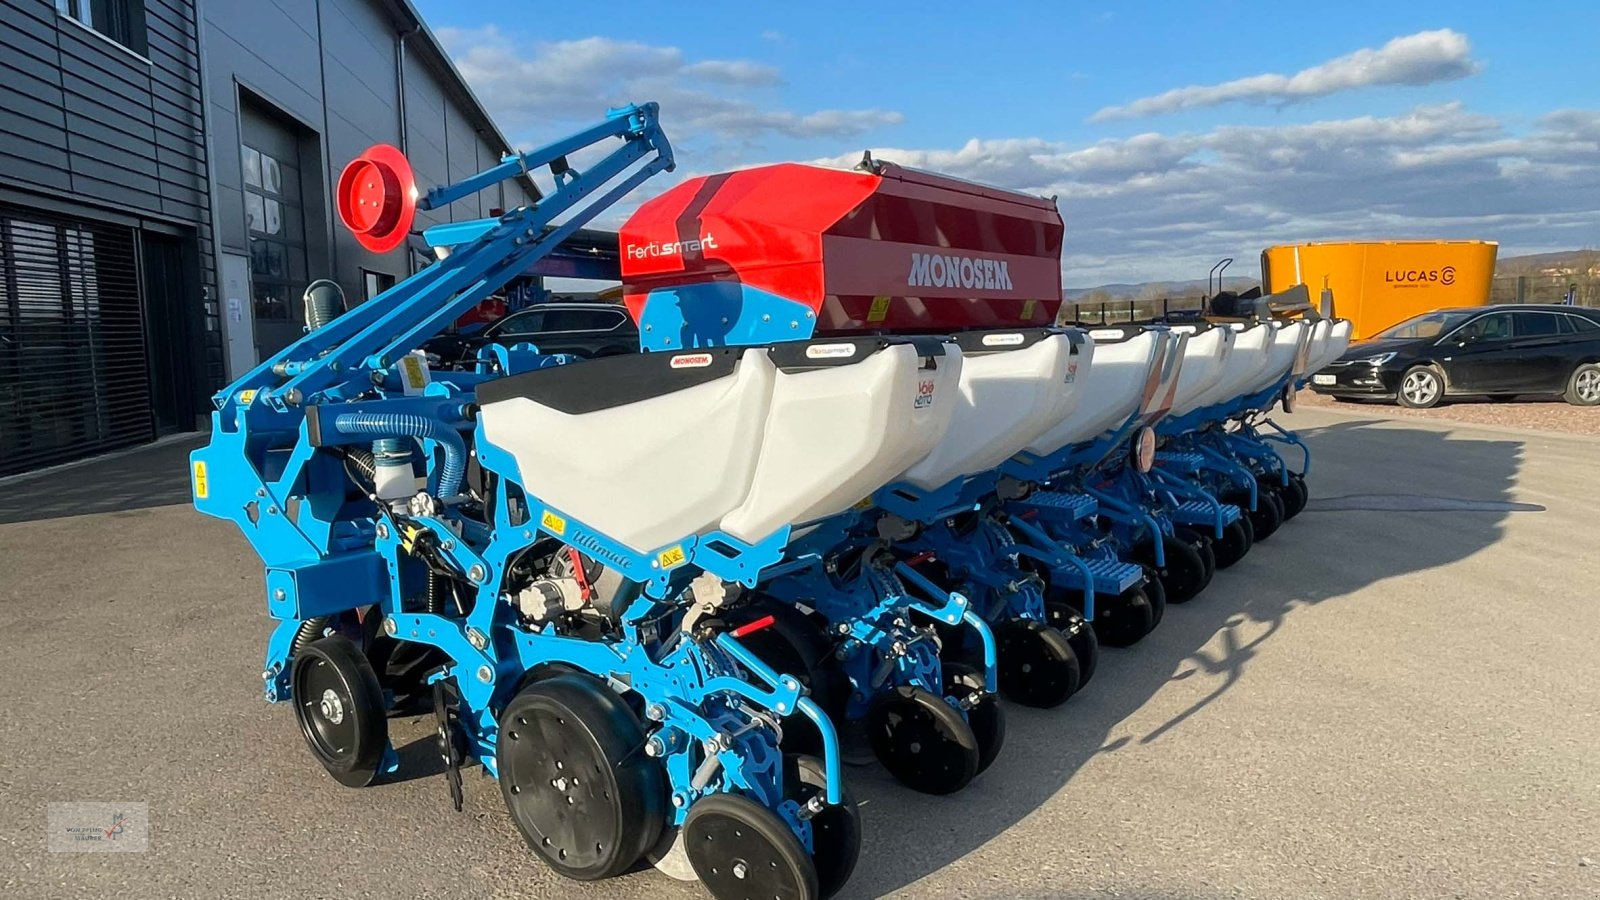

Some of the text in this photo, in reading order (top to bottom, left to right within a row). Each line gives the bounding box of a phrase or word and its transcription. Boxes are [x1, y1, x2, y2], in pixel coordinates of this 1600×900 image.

[908, 253, 1013, 290] MONOSEM
[1385, 270, 1438, 282] LUCAS
[673, 356, 709, 365] MONOSEM
[573, 530, 632, 569] Ultimate
